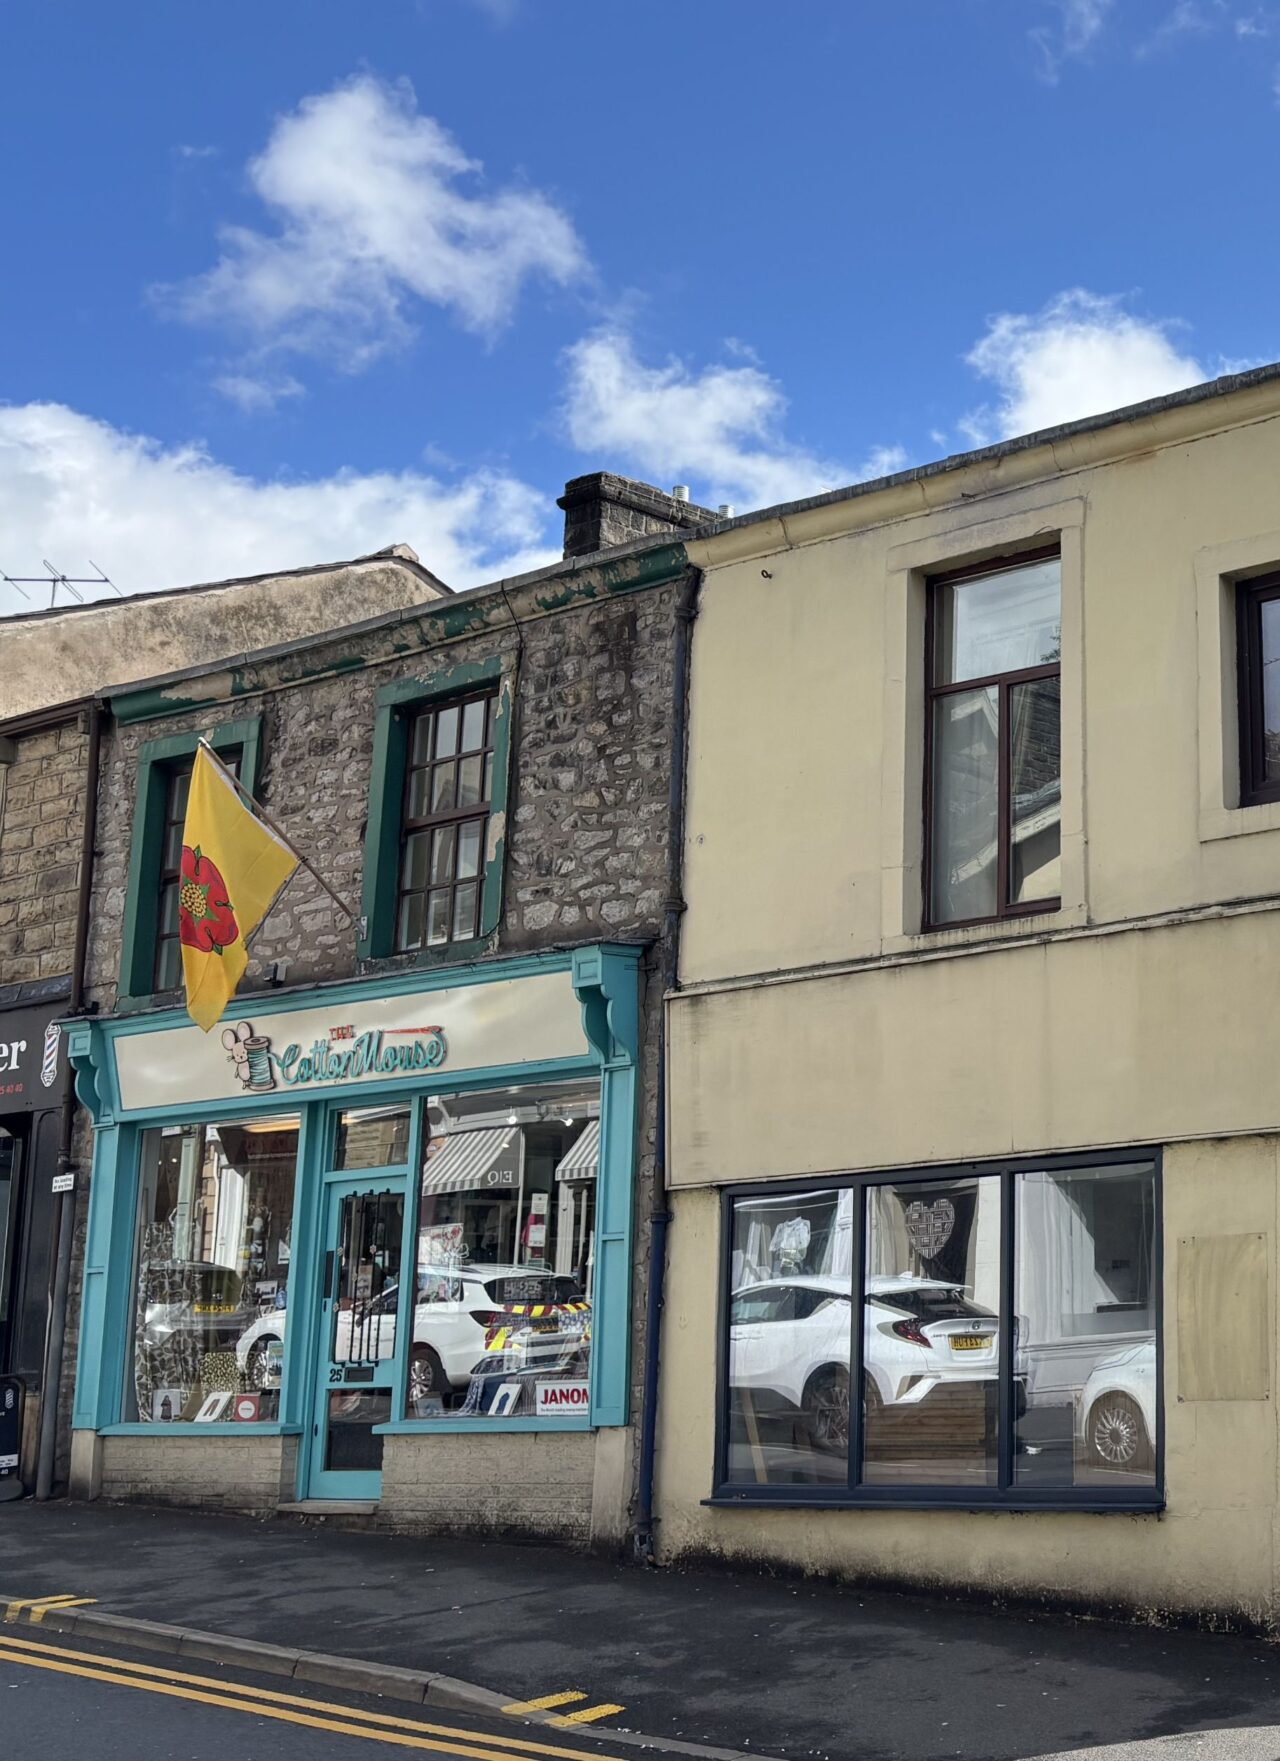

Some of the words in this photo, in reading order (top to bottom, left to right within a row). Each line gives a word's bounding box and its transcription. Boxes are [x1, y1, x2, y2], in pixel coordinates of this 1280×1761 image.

[280, 1039, 357, 1085] Cotton
[353, 1029, 443, 1073] Mouse
[329, 1368, 342, 1382] 25
